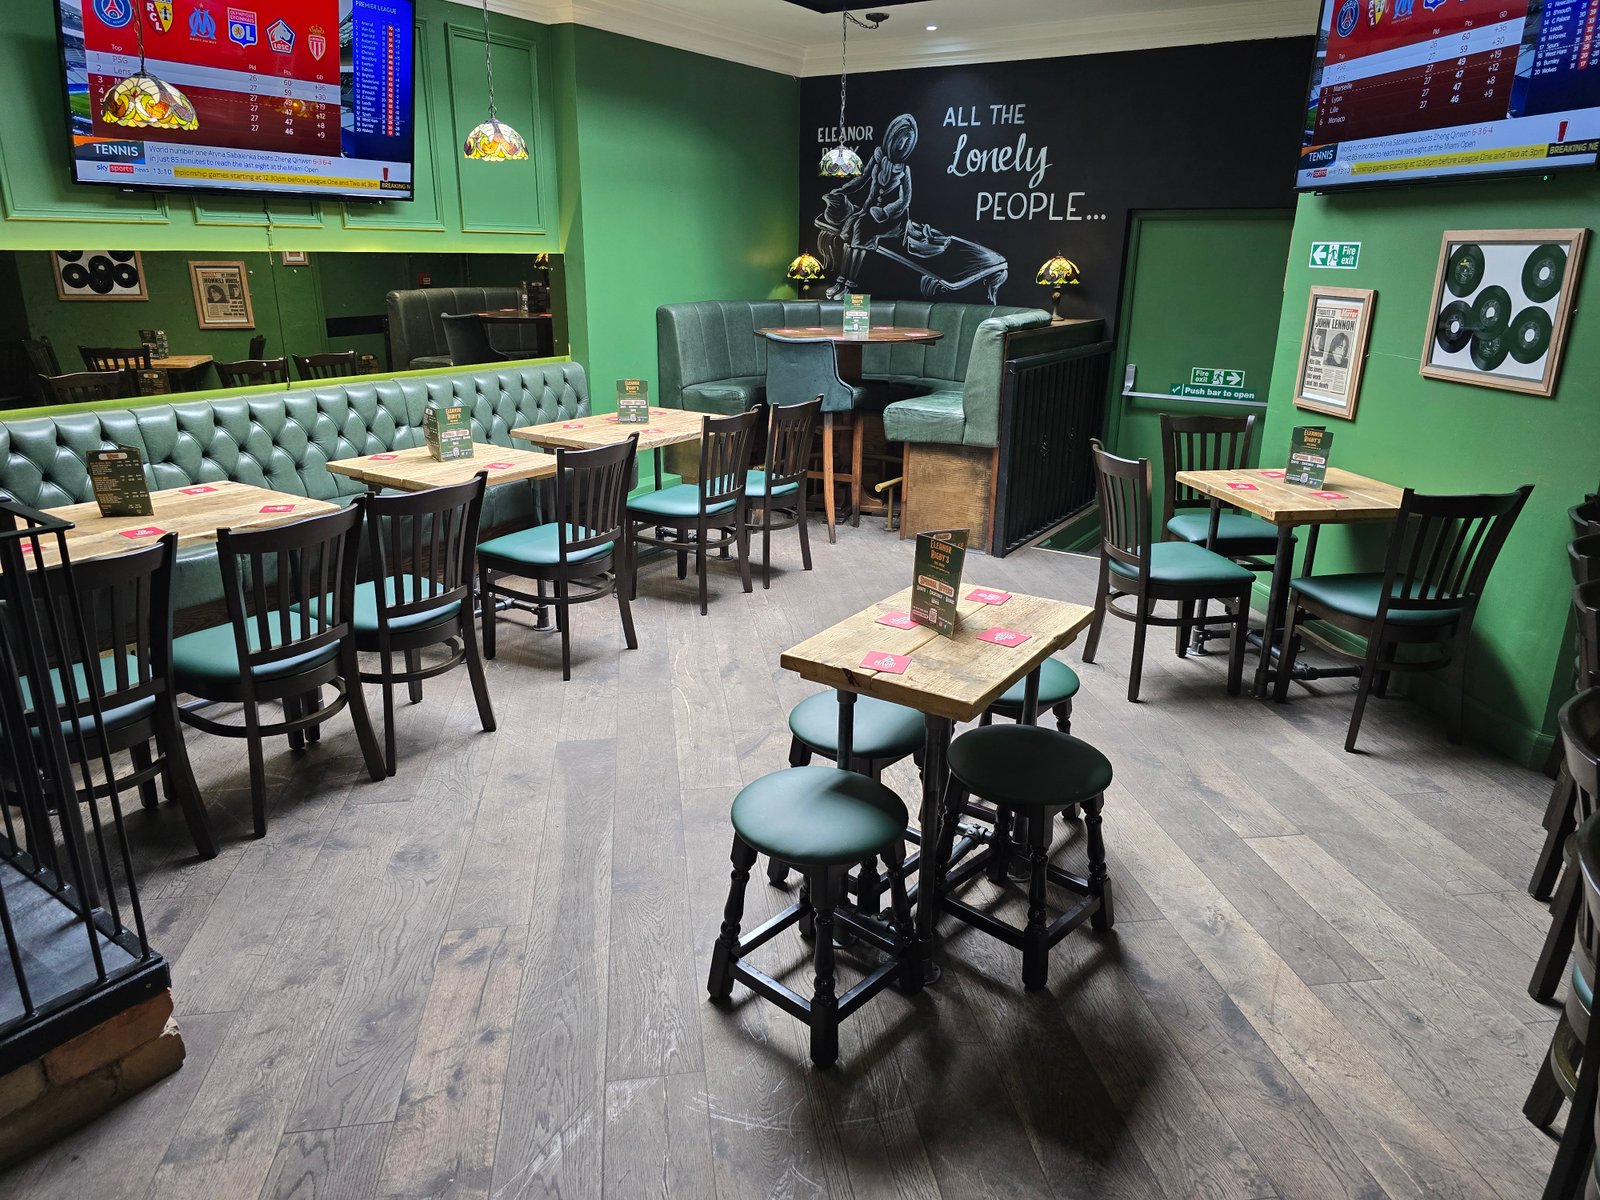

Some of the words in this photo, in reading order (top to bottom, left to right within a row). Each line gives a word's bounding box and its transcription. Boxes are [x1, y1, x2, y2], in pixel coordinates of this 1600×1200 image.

[356, 0, 376, 10] PREMIER
[378, 5, 396, 14] LEAGUE
[1462, 32, 1471, 40] 60
[111, 44, 122, 52] Top
[1460, 45, 1468, 54] 59
[112, 56, 128, 64] PSG
[1426, 64, 1434, 73] 27
[1457, 57, 1466, 66] 49
[1490, 50, 1502, 59] +19
[113, 66, 132, 76] Lens
[1332, 96, 1342, 104] Lyon
[1424, 76, 1432, 84] 27
[1455, 70, 1464, 78] 47
[1488, 63, 1500, 72] +12
[1330, 106, 1340, 114] Lille
[1422, 88, 1430, 96] 27
[1452, 82, 1462, 90] 47
[1486, 76, 1496, 84] +8
[1328, 116, 1346, 124] Monaco
[1420, 100, 1428, 108] 27
[1450, 94, 1460, 103] 46
[1484, 89, 1494, 98] +9
[943, 106, 981, 127] ALL
[990, 104, 1026, 125] THE
[817, 126, 874, 142] ELEANOR
[1472, 128, 1482, 136] 6-3
[93, 144, 138, 156] TENNIS
[1460, 140, 1476, 150] Open
[1506, 150, 1520, 158] Two
[1530, 148, 1544, 158] 3pm
[1549, 144, 1587, 154] BREAKING
[1588, 142, 1599, 150] NE
[148, 145, 168, 153] World
[208, 150, 226, 158] Aryna
[257, 154, 274, 162] beats
[274, 156, 292, 164] Zheng
[946, 132, 1053, 188] Lonely
[1309, 150, 1334, 162] TENNIS
[254, 162, 270, 170] eight
[96, 164, 108, 172] sky
[110, 165, 134, 173] sports
[288, 176, 306, 184] before
[306, 178, 326, 186] League
[976, 192, 1106, 221] PEOPLE...
[1342, 245, 1356, 256] Fire
[1341, 256, 1354, 265] exit
[1315, 318, 1330, 328] JOHN
[1331, 319, 1356, 330] LENNON
[1184, 386, 1205, 395] Push
[1206, 388, 1222, 396] bar
[1234, 392, 1255, 400] open
